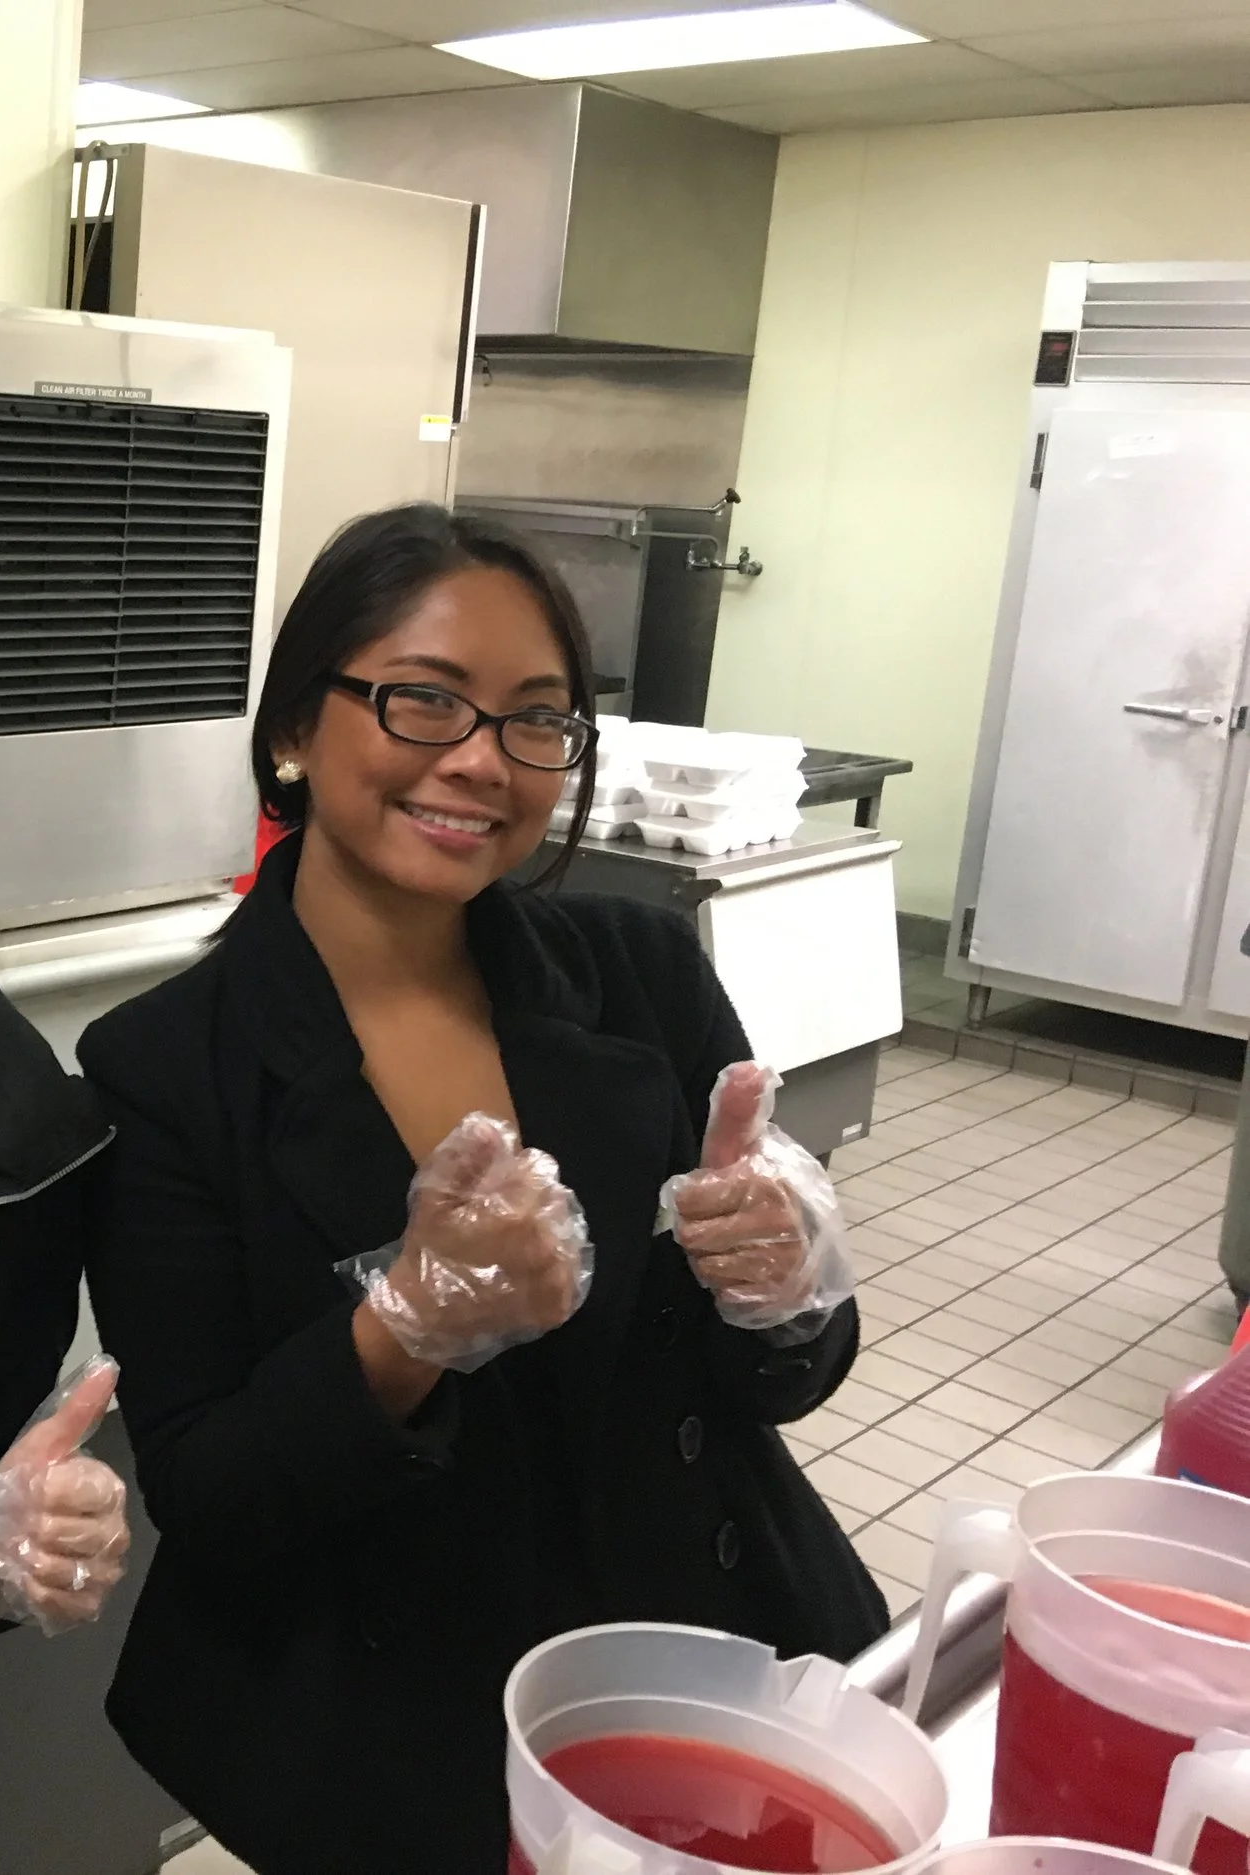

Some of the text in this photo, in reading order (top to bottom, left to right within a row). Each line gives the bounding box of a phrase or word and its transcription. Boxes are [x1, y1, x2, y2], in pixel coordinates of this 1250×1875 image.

[41, 384, 146, 399] CLEAN AIR FILTER TWICE A MONTH
